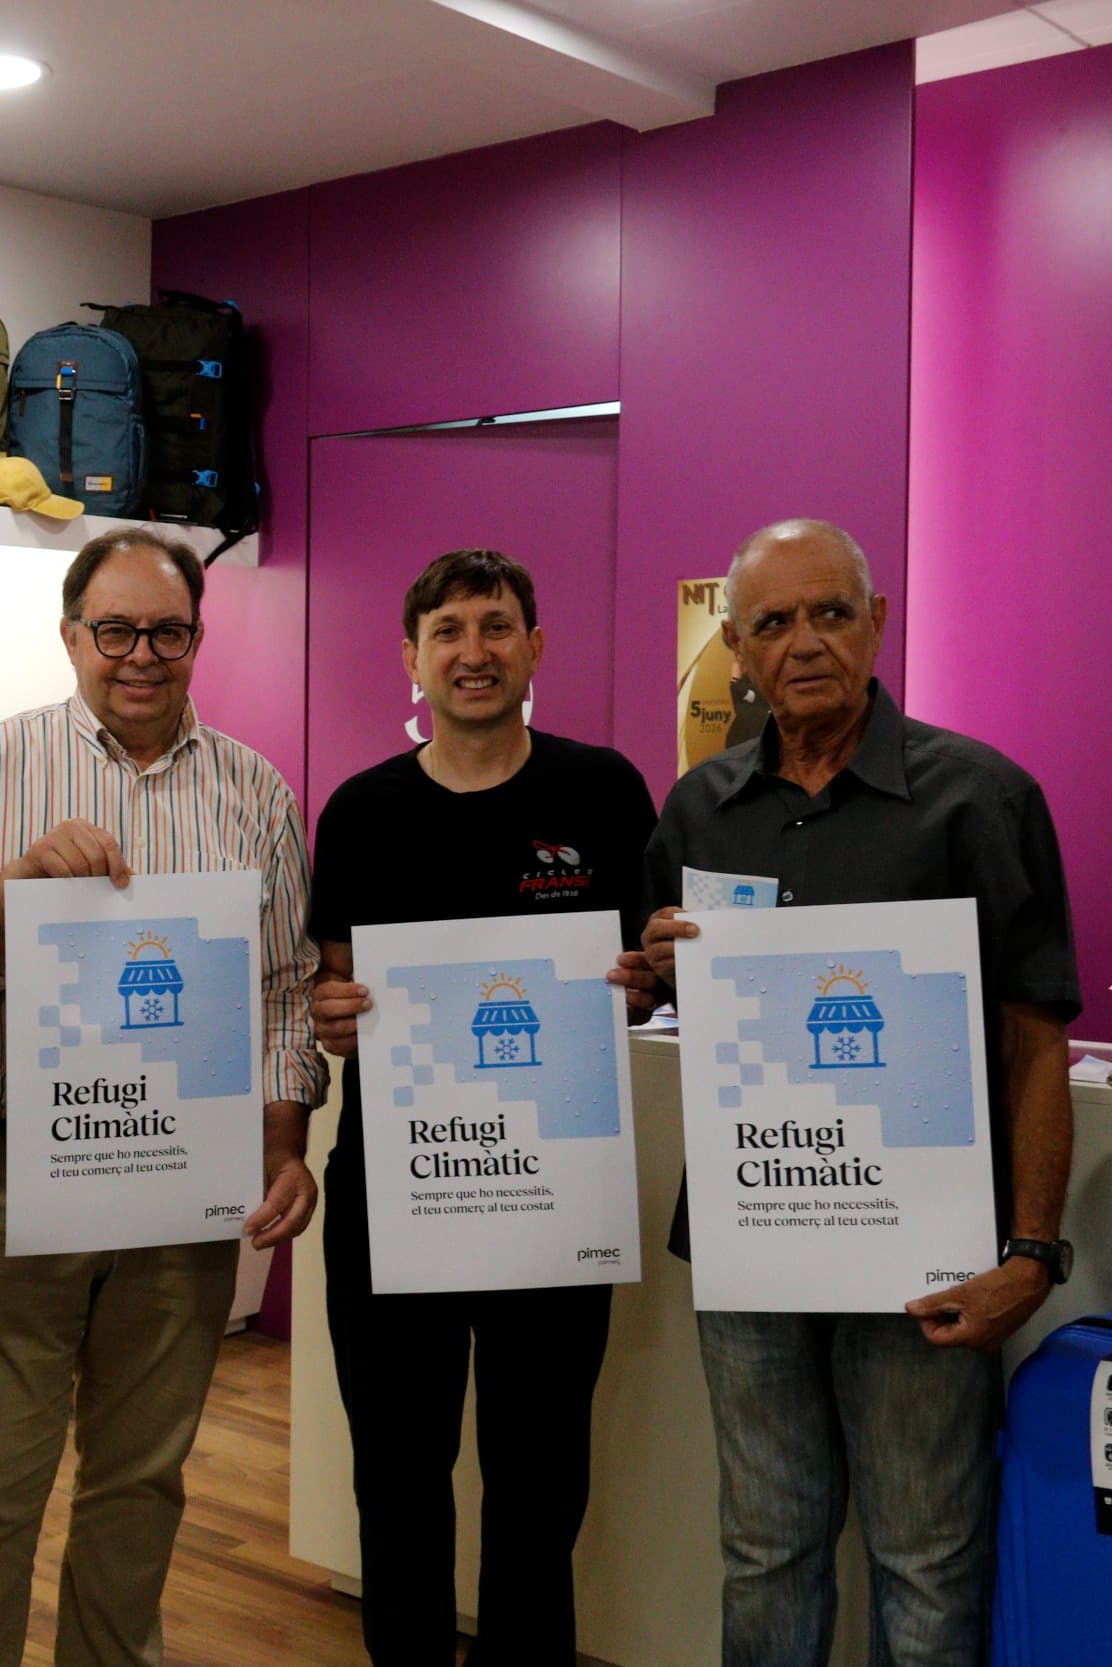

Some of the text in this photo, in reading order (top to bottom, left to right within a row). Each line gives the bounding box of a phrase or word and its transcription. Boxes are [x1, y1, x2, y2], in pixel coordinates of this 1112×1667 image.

[682, 583, 719, 616] NIT
[701, 708, 731, 724] juny
[52, 1075, 148, 1109] Refugi
[52, 1109, 176, 1141] Climàtic
[409, 1114, 506, 1148] Refugi
[736, 1119, 845, 1155] Refugi
[50, 1152, 92, 1165] Sempre
[94, 1152, 115, 1162] que
[117, 1149, 131, 1159] ho
[410, 1149, 539, 1179] Climàtic
[50, 1161, 188, 1178] el teu comerç al teu costat
[737, 1157, 883, 1187] Climàtic
[411, 1191, 454, 1202] Sempre
[456, 1190, 476, 1200] que
[479, 1188, 494, 1198] ho
[205, 1205, 246, 1219] pimec
[412, 1201, 554, 1216] el teu comerç al teu costat
[738, 1200, 786, 1213] Sempre
[788, 1201, 811, 1212] que
[814, 1199, 830, 1210] ho
[738, 1215, 899, 1229] el teu comerç al teu costat
[577, 1248, 621, 1262] pimec
